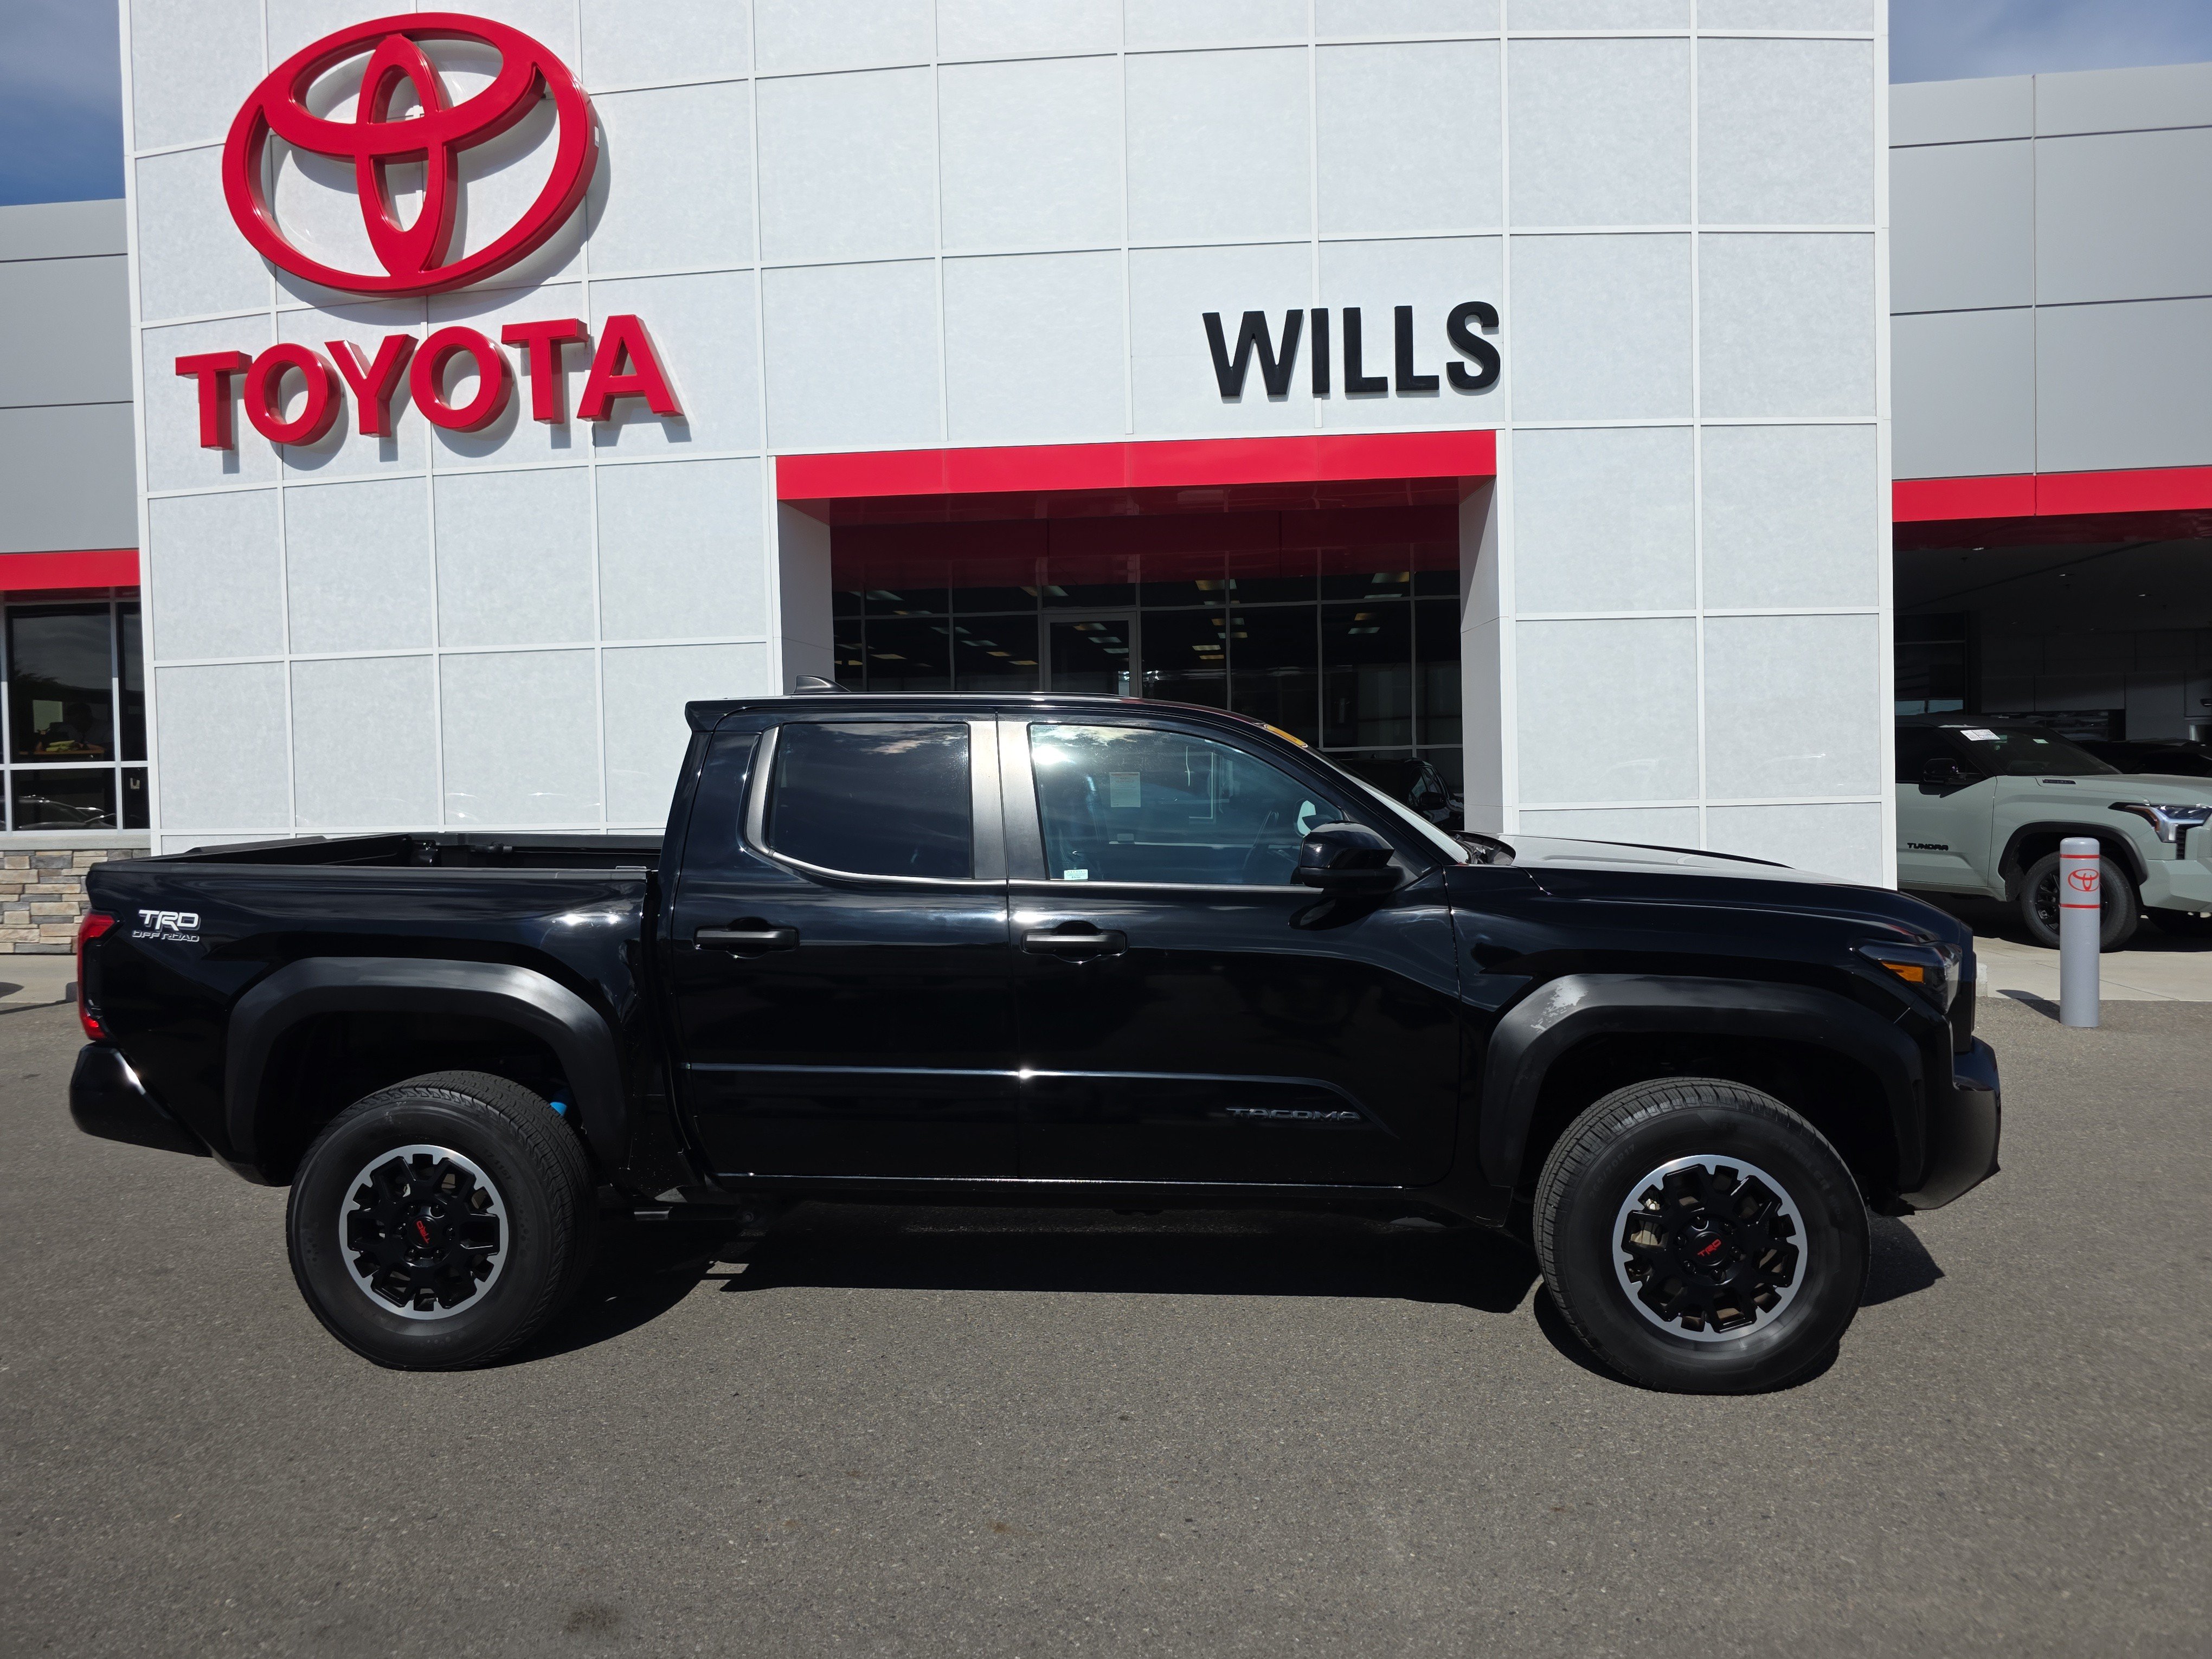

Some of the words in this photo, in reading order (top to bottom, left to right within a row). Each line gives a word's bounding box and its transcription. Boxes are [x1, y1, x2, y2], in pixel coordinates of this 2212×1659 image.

[1203, 301, 1501, 397] WILLS
[176, 315, 683, 451] TOYOTA
[1907, 843, 1949, 851] TUNDRA
[139, 910, 201, 931] TRD
[132, 930, 160, 939] OFF
[161, 933, 200, 942] ROAD
[1225, 1107, 1360, 1121] TACOMA
[416, 1220, 430, 1244] TRD
[1697, 1239, 1721, 1256] TRD
